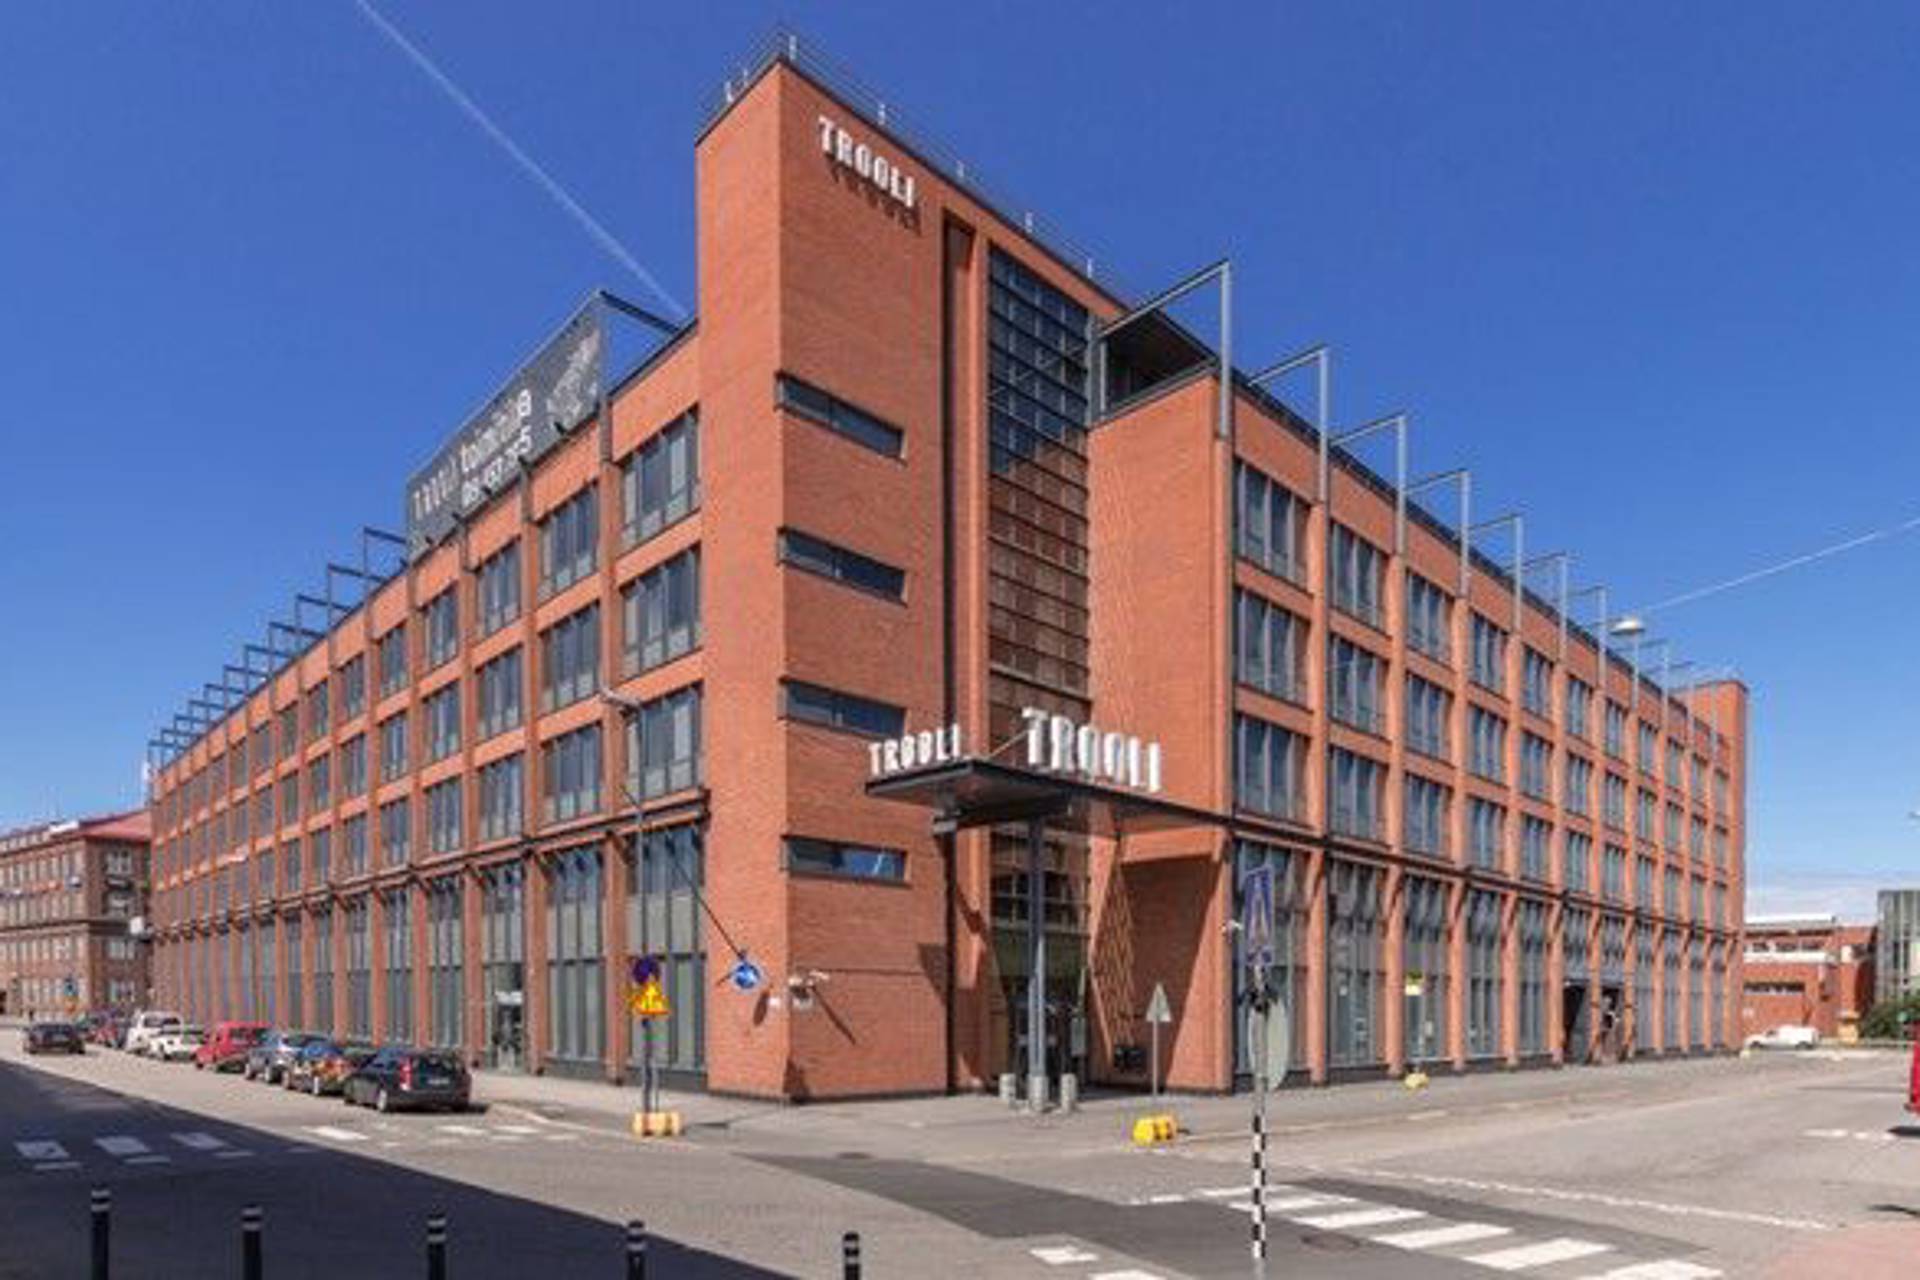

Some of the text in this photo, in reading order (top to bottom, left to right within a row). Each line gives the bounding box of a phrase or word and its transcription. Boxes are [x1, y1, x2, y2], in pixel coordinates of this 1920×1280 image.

[818, 115, 915, 208] TROOLI
[868, 722, 959, 776] TROOLI
[1022, 706, 1161, 792] TROOLI
